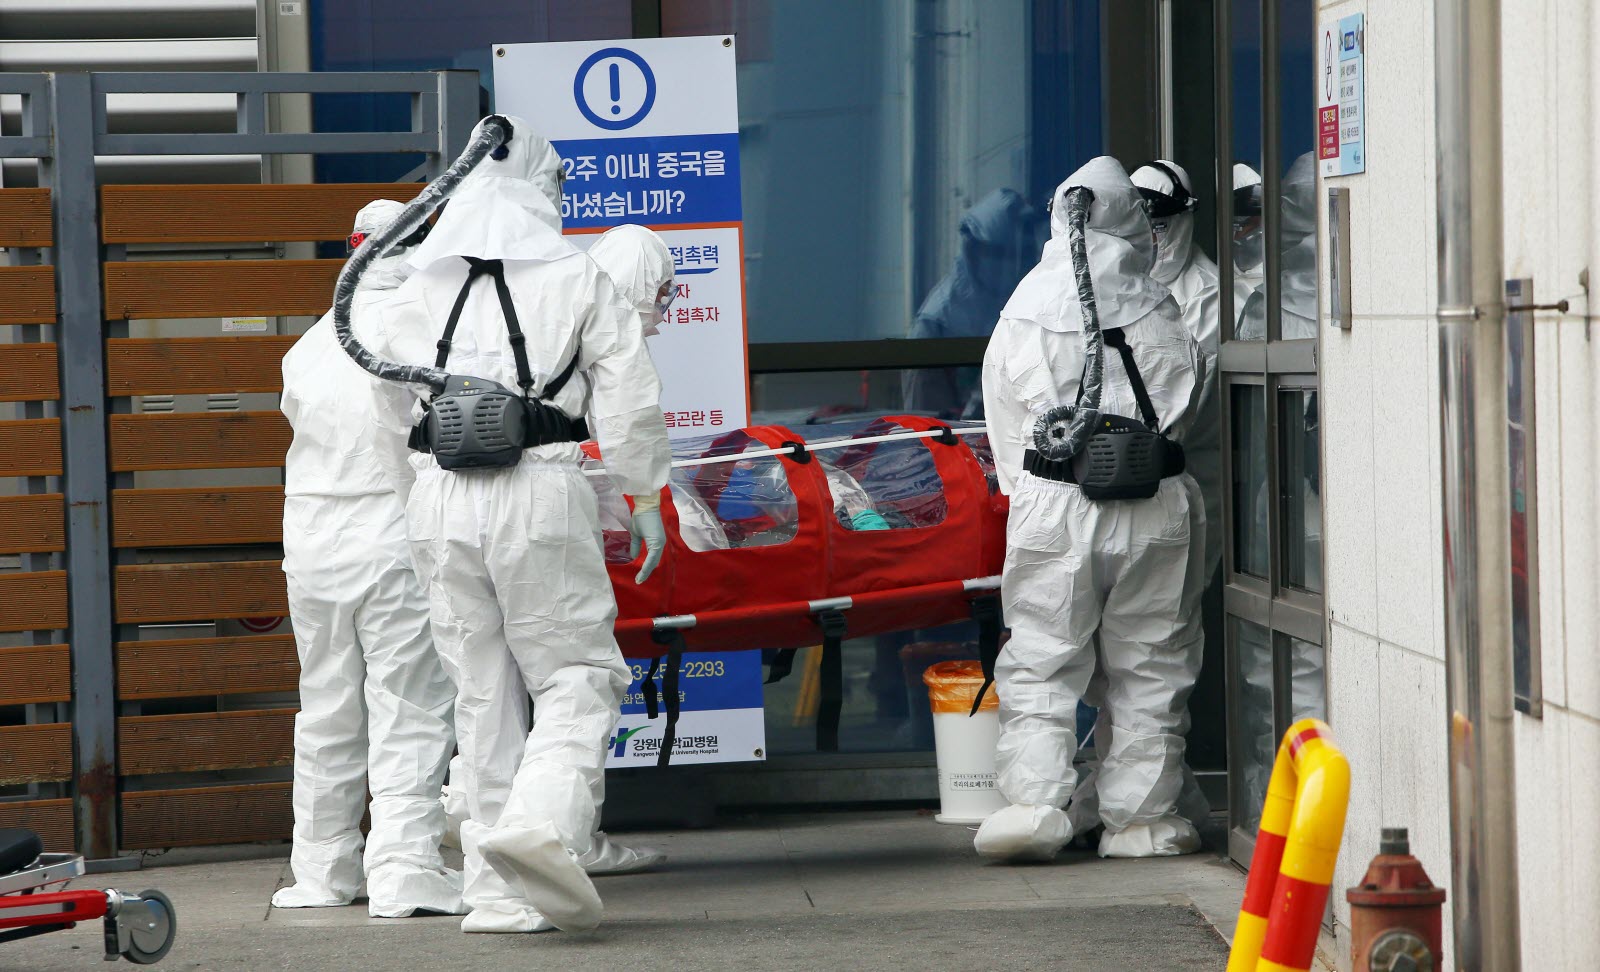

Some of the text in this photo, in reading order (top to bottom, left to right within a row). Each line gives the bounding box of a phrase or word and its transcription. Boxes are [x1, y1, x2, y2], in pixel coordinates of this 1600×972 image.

[564, 150, 726, 182] 2주 이내 중국을
[710, 409, 723, 426] 등
